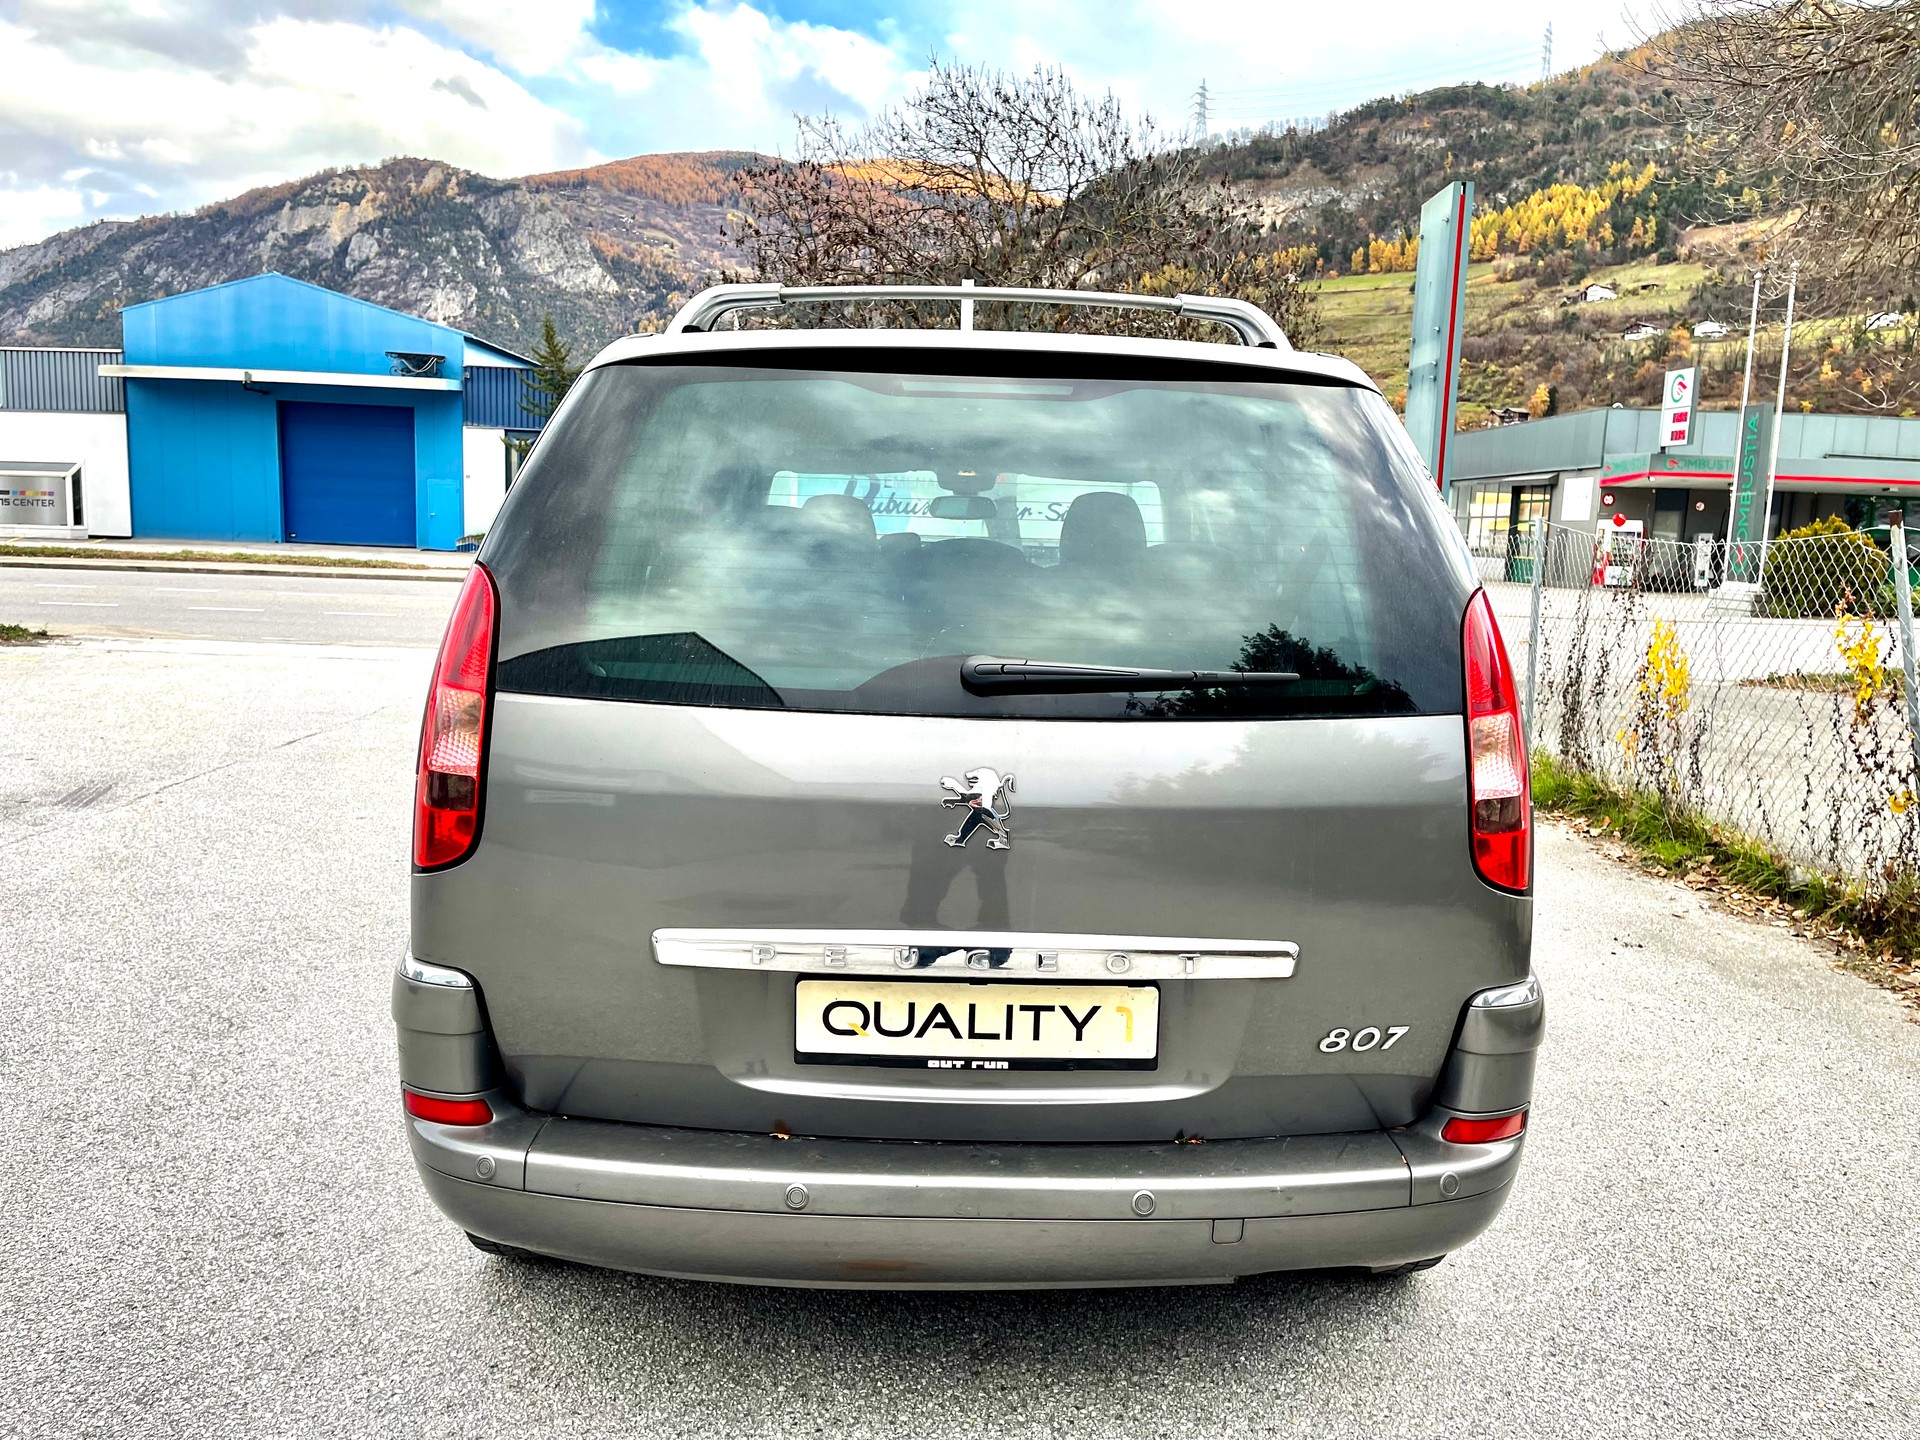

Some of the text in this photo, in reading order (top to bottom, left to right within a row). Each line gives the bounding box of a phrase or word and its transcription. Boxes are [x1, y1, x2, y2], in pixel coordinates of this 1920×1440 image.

[12, 498, 55, 508] CENTER
[752, 944, 1201, 974] PEUGEOT
[822, 1000, 1102, 1042] QUALITY
[1318, 1025, 1411, 1053] 807
